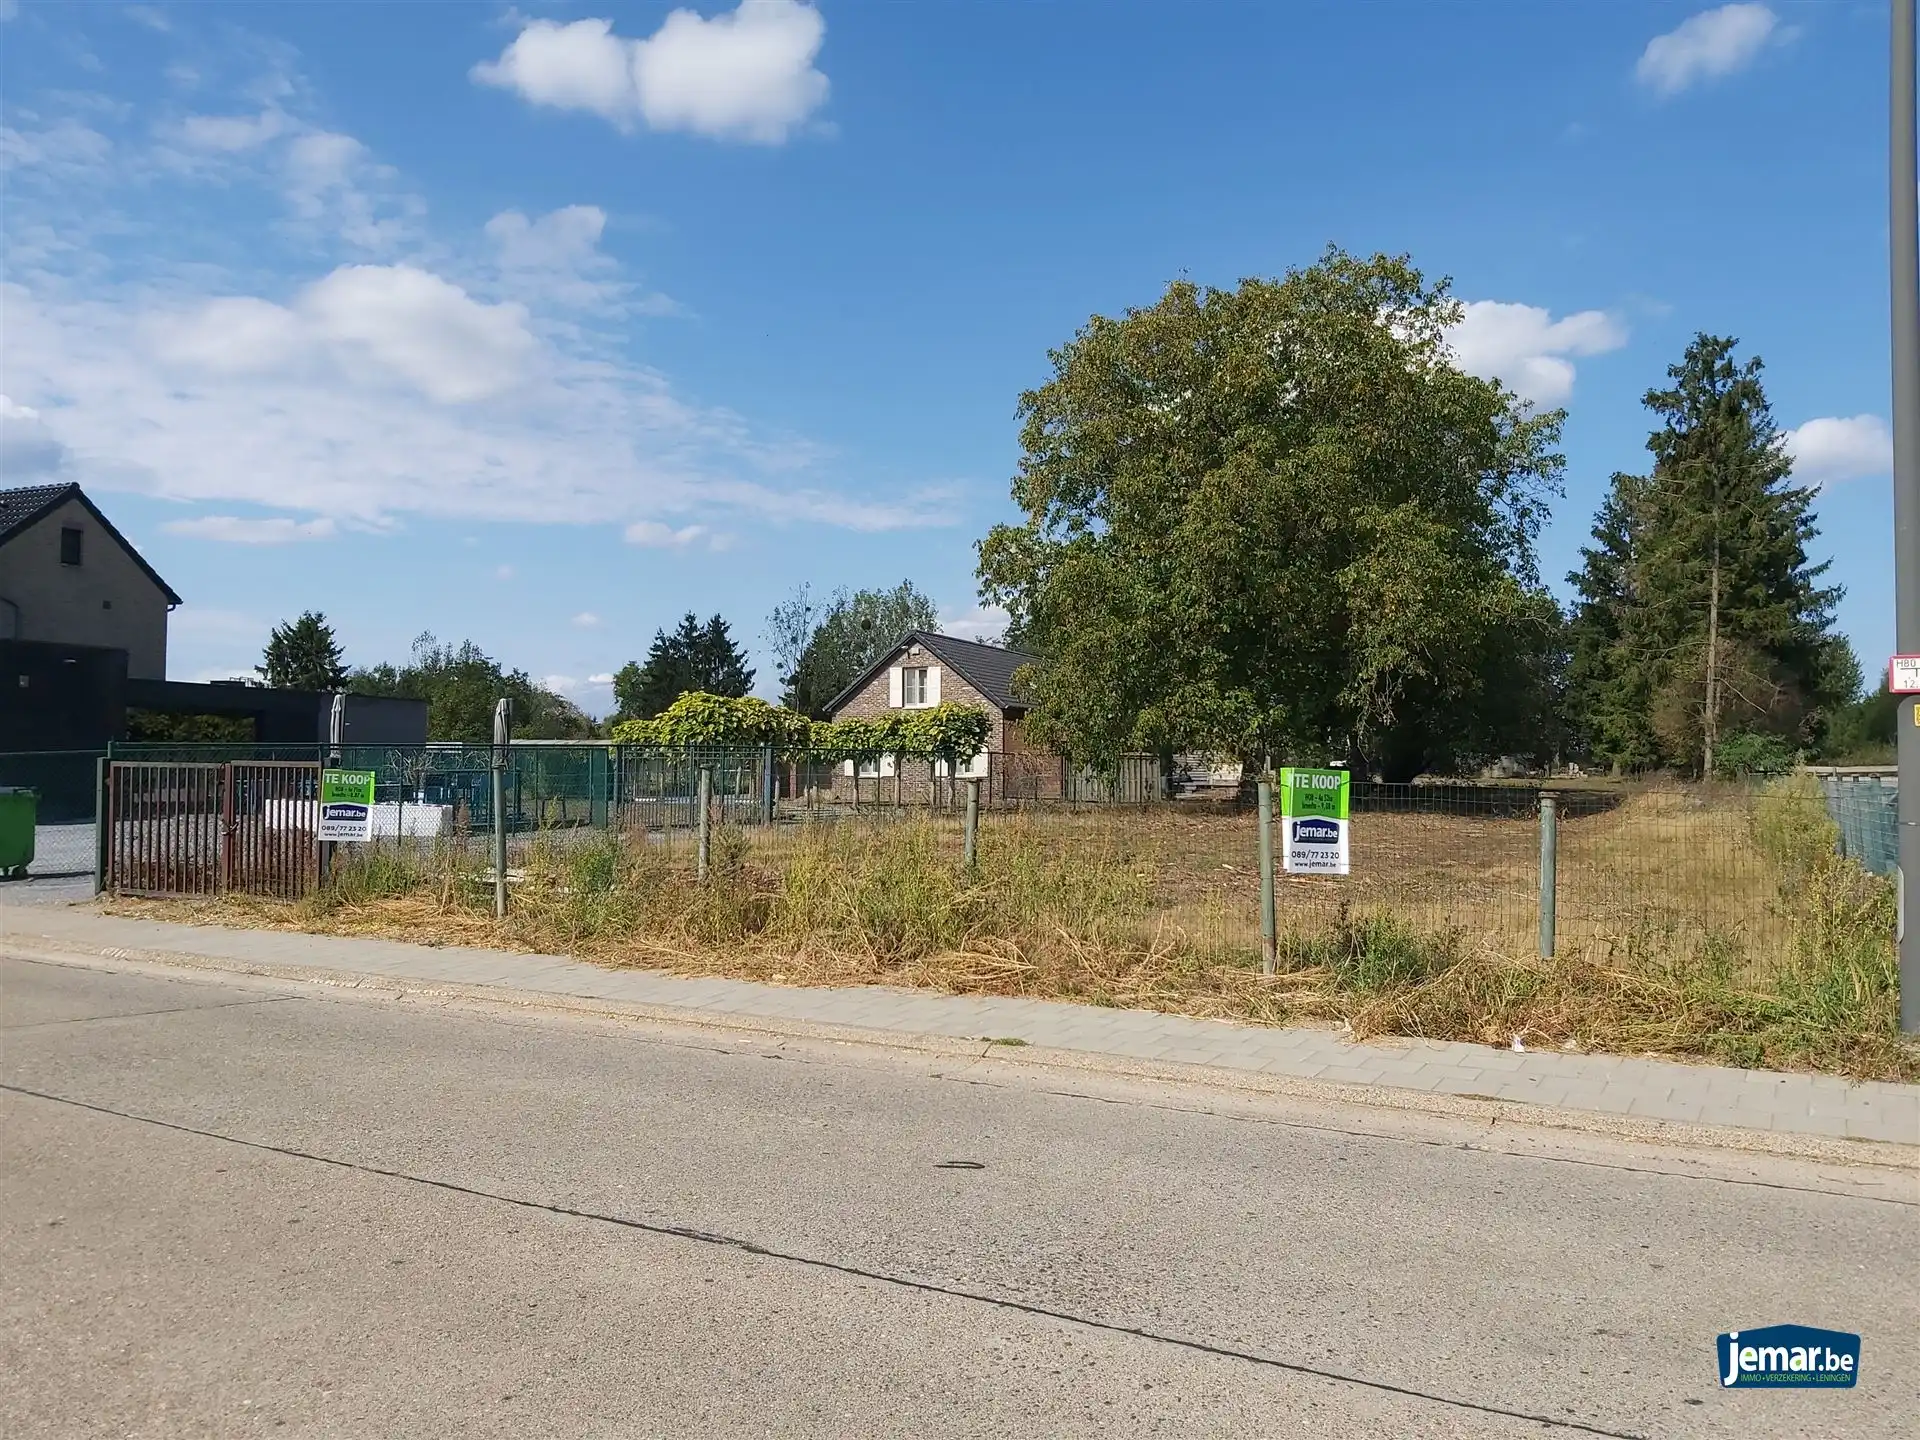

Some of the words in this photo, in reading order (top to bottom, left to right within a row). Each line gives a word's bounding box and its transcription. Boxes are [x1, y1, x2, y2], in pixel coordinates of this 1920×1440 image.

[325, 773, 340, 784] TE
[341, 774, 371, 785] KOOP
[1294, 773, 1309, 788] TE
[1311, 774, 1341, 790] KOOP
[324, 805, 367, 819] jemar.be
[1294, 821, 1338, 842] jemar.be
[1294, 860, 1337, 868] www.jemar.be
